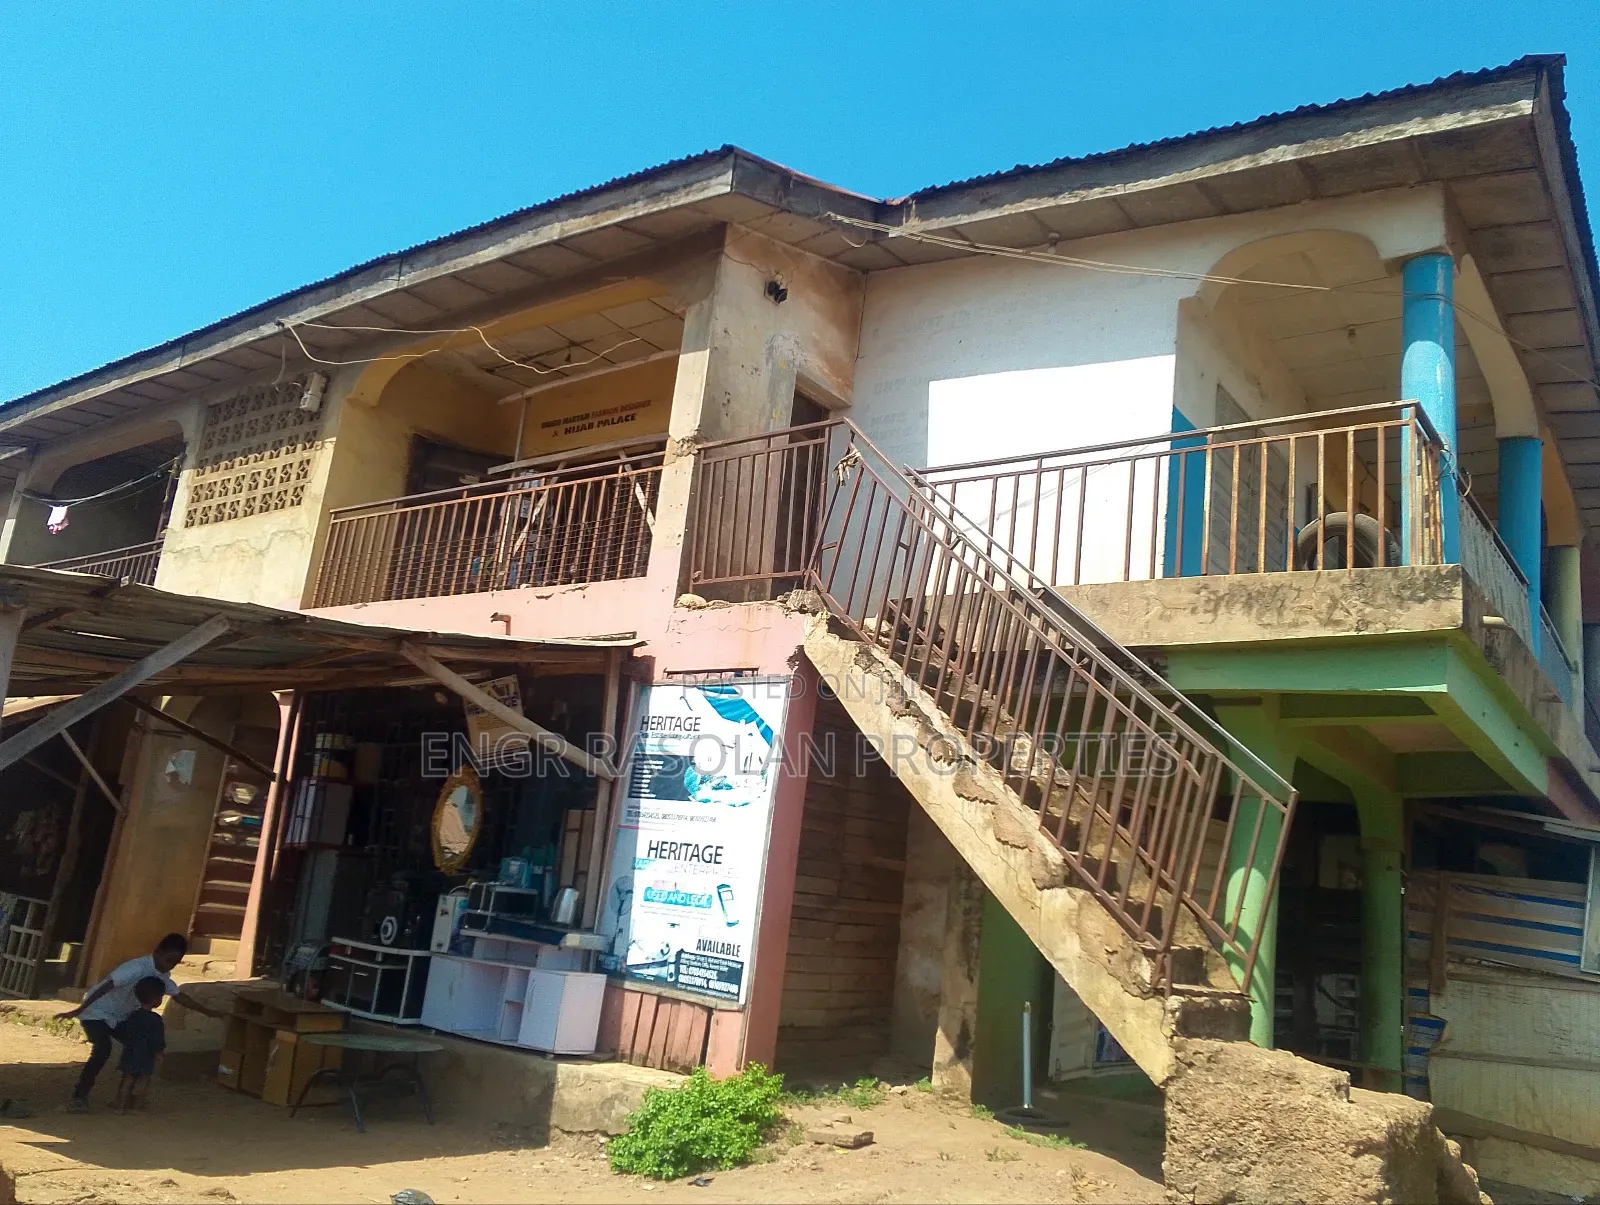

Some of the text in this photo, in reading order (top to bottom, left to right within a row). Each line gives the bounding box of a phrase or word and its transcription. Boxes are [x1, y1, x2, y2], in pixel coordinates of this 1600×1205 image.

[591, 407, 619, 419] FASHION
[620, 399, 652, 412] DESIGNER
[564, 422, 595, 435] HIJAB
[597, 413, 637, 428] PALACE
[640, 715, 702, 732] HERITAGE
[647, 839, 724, 865] HERITAGE
[696, 938, 741, 958] AVAILABLE
